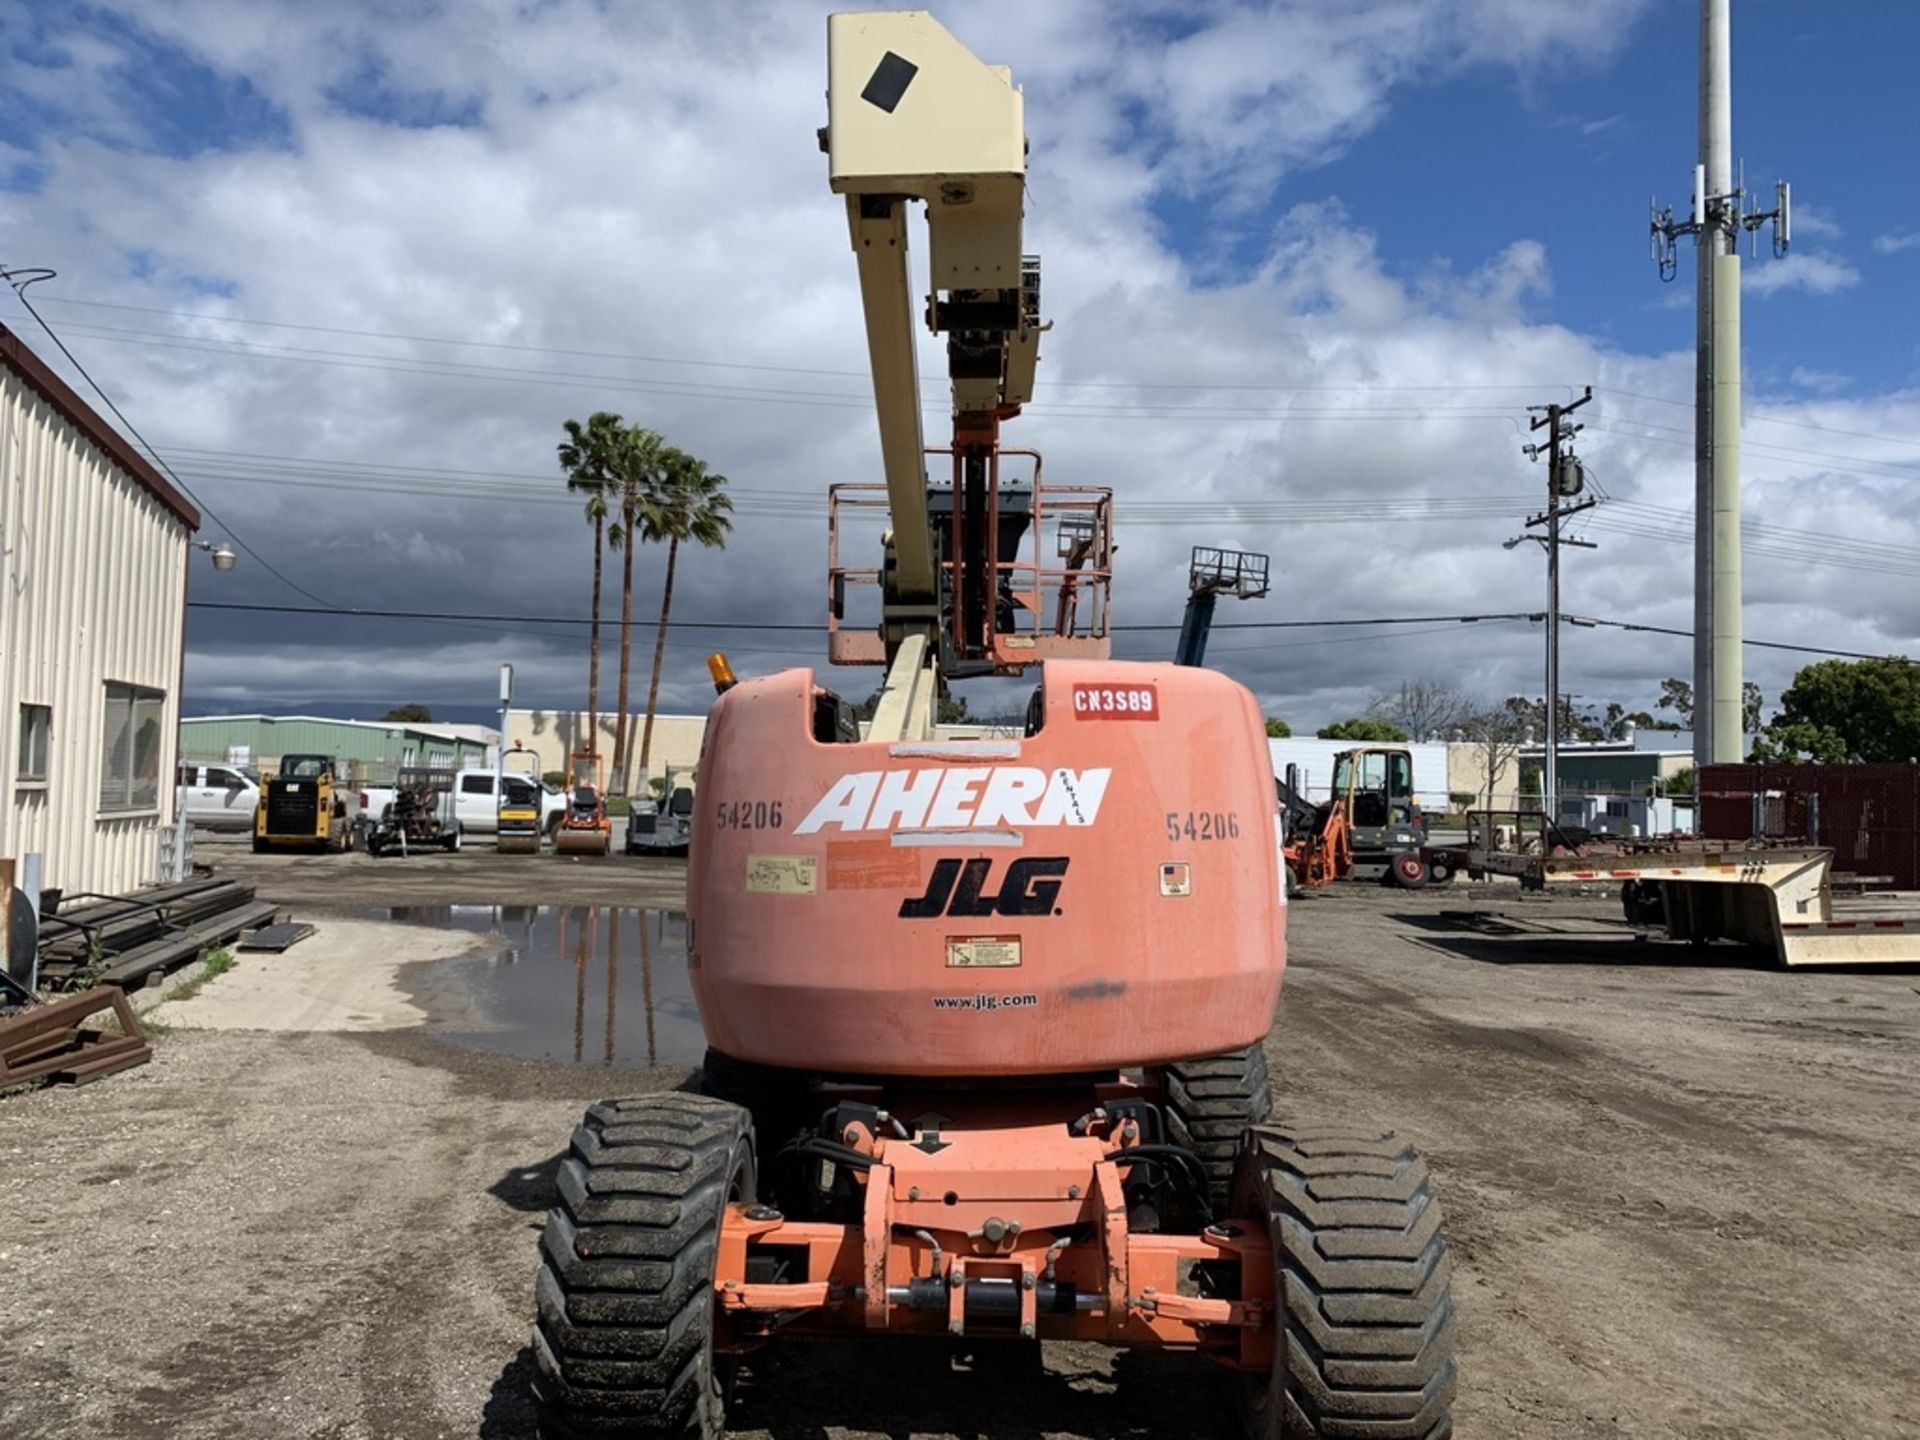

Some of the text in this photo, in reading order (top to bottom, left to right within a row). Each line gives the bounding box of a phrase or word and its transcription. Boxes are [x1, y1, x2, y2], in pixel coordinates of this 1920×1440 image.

[1075, 689, 1152, 712] CN3S89
[793, 767, 1112, 835] AHERN
[1059, 770, 1085, 824] RENTALS
[717, 801, 782, 830] 54206
[1166, 811, 1239, 841] 54206
[933, 994, 1037, 1010] www.jlg.com
